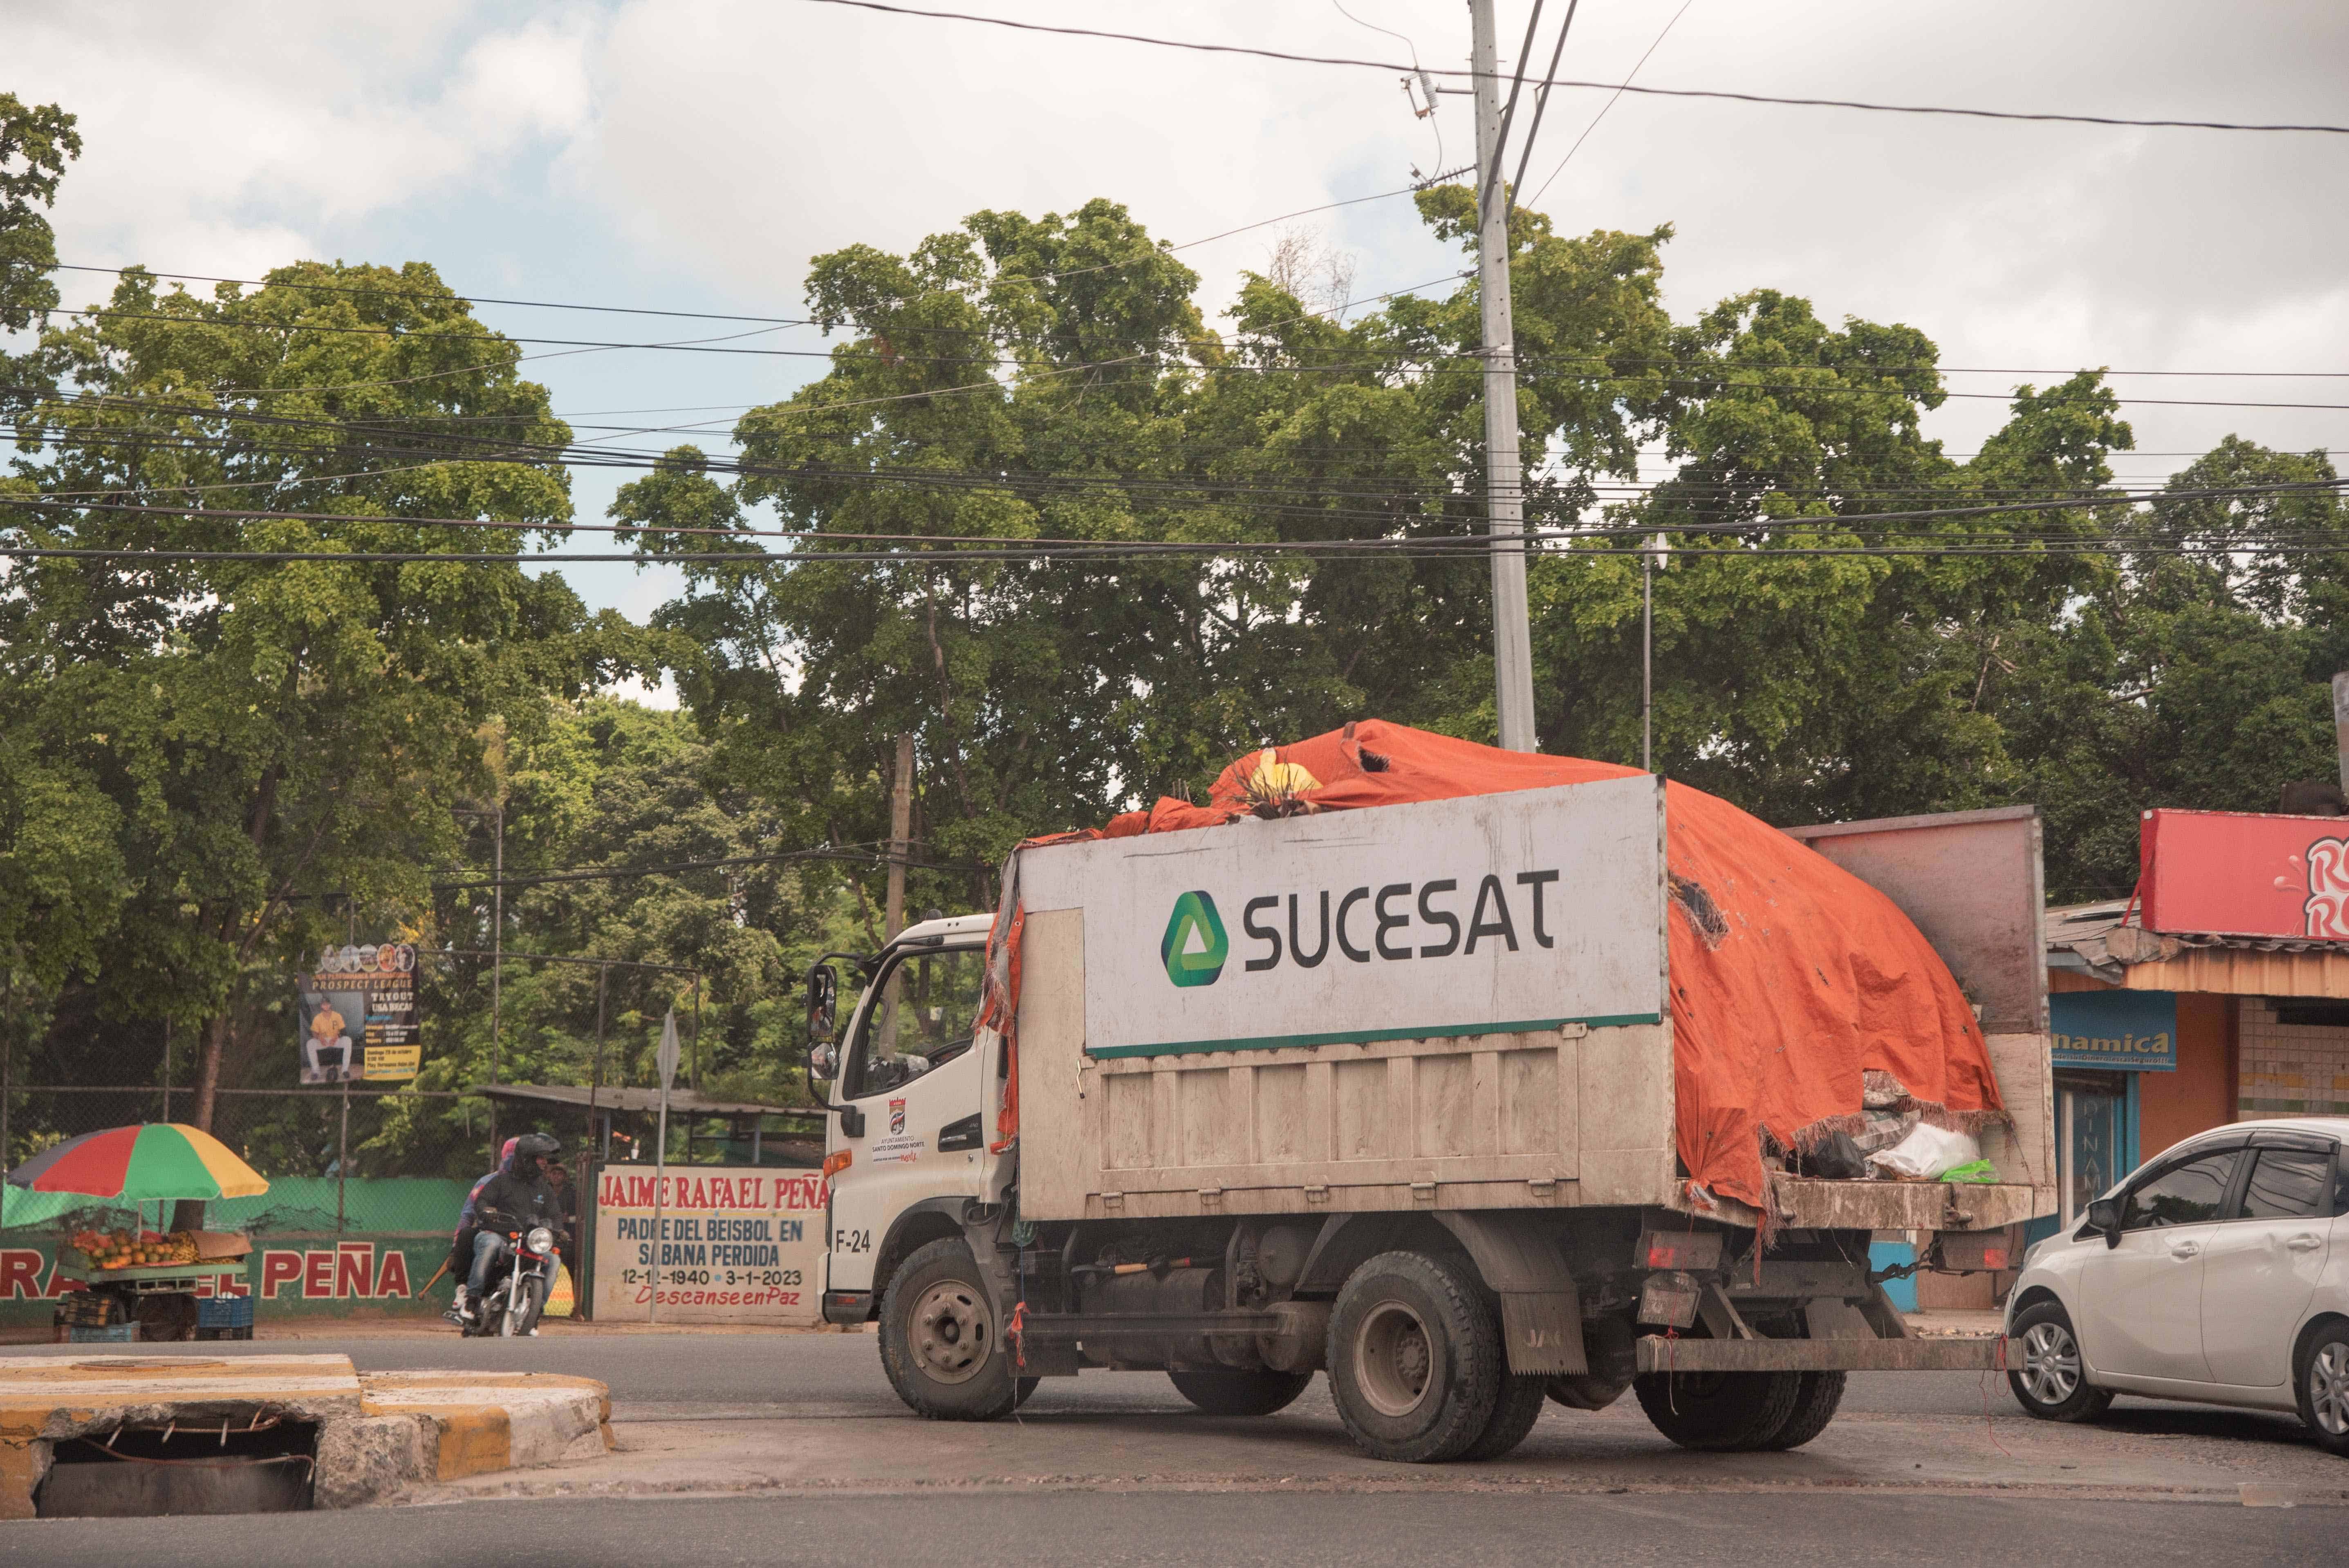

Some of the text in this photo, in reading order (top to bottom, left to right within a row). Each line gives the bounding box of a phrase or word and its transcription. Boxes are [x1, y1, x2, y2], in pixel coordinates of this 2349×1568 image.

[1243, 869, 1559, 972] SUCESAT
[312, 979, 412, 990] PROSPECT LEAGUE
[371, 992, 413, 1001] TRYOUT
[599, 1173, 830, 1210] JAIME RAFAEL PEÑA
[674, 1219, 703, 1241] DEL
[707, 1219, 772, 1241] BEISBOL
[780, 1220, 803, 1242] EN
[836, 1230, 870, 1253] F-24
[712, 1245, 779, 1266] PERDIDA
[261, 1241, 412, 1298] PEÑA
[726, 1270, 802, 1286] 3-1-2023
